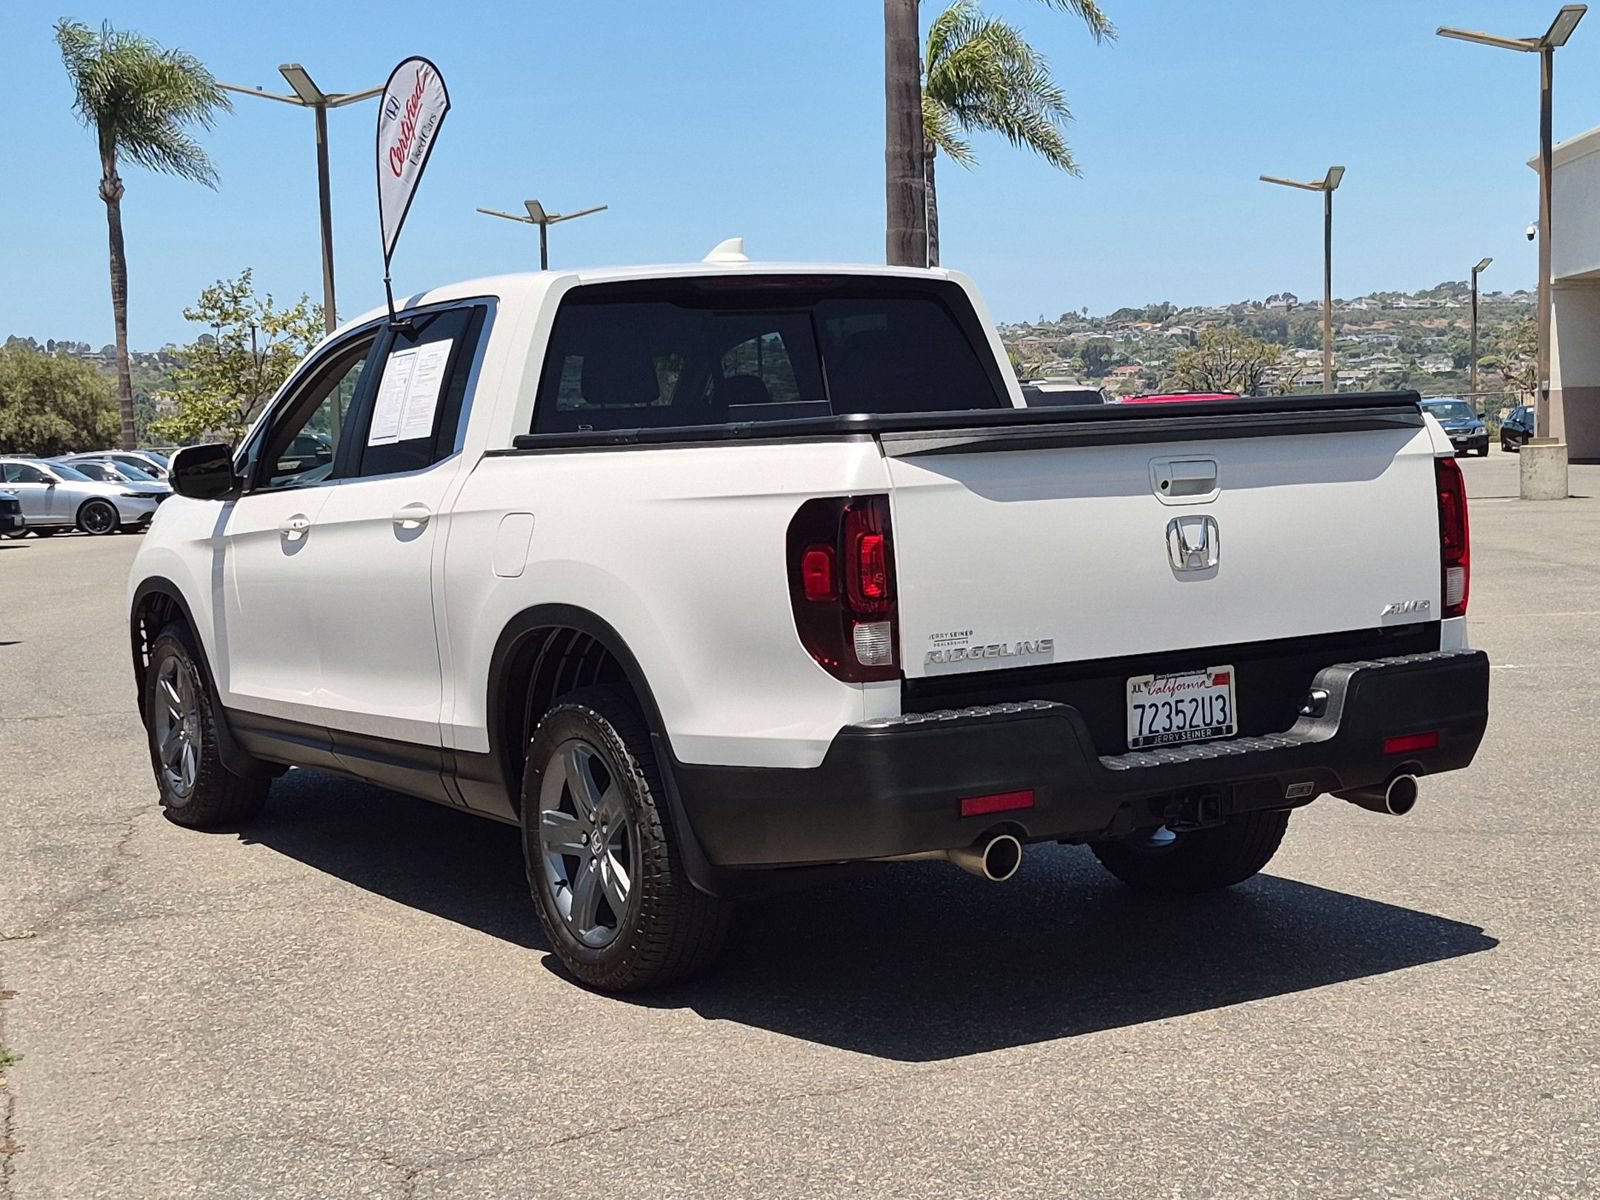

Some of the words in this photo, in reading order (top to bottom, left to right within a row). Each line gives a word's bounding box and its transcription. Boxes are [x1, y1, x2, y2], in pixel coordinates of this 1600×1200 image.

[390, 69, 428, 177] Certified
[409, 136, 427, 166] Used
[421, 113, 437, 137] Cars
[928, 633, 948, 641] JERRY
[924, 639, 1054, 666] RIDGELINE
[1148, 678, 1211, 698] California
[1133, 694, 1228, 736] 72352U3
[1153, 734, 1180, 745] JERRY
[1181, 728, 1213, 741] SEINER
